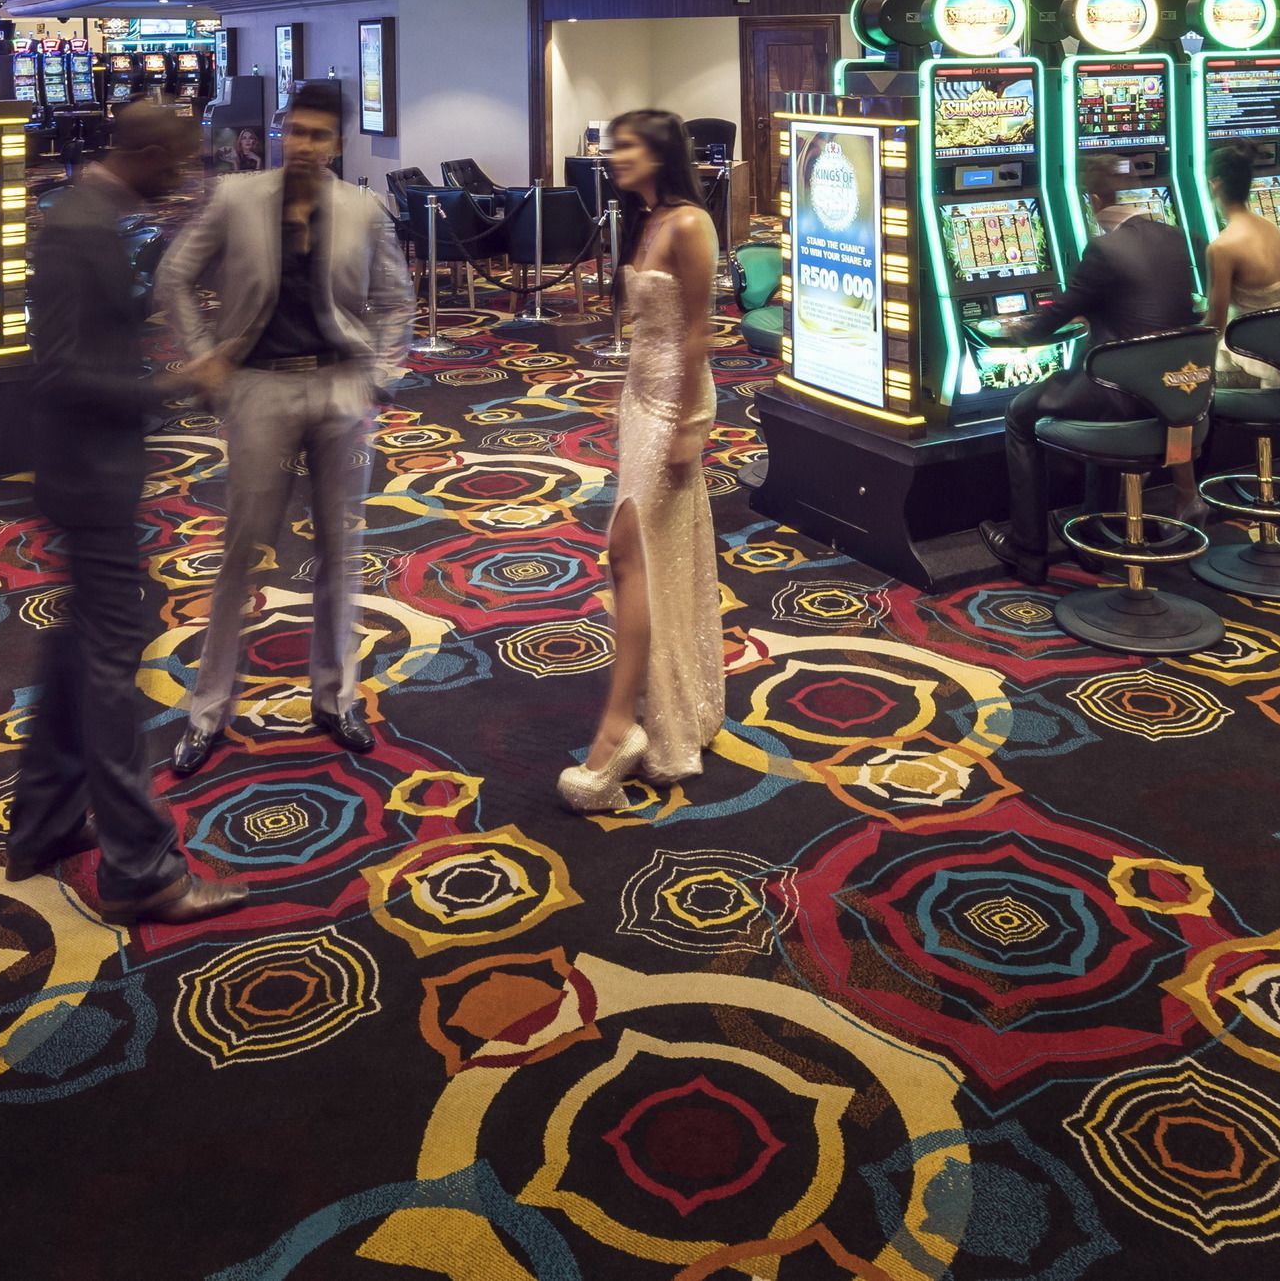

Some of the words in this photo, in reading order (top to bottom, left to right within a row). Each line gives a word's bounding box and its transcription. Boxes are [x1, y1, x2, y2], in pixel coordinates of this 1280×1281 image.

[945, 98, 1025, 119] SUNSTRIKER
[815, 168, 840, 182] KINGS
[842, 171, 854, 183] OF
[806, 236, 826, 248] STAND
[827, 240, 839, 250] THE
[839, 242, 866, 255] CHANCE
[800, 245, 809, 255] TO
[809, 247, 822, 258] WIN
[823, 250, 840, 262] YOUR
[841, 254, 862, 266] SHARE
[863, 258, 872, 268] OF
[800, 263, 839, 292] R500
[842, 273, 874, 301] 000
